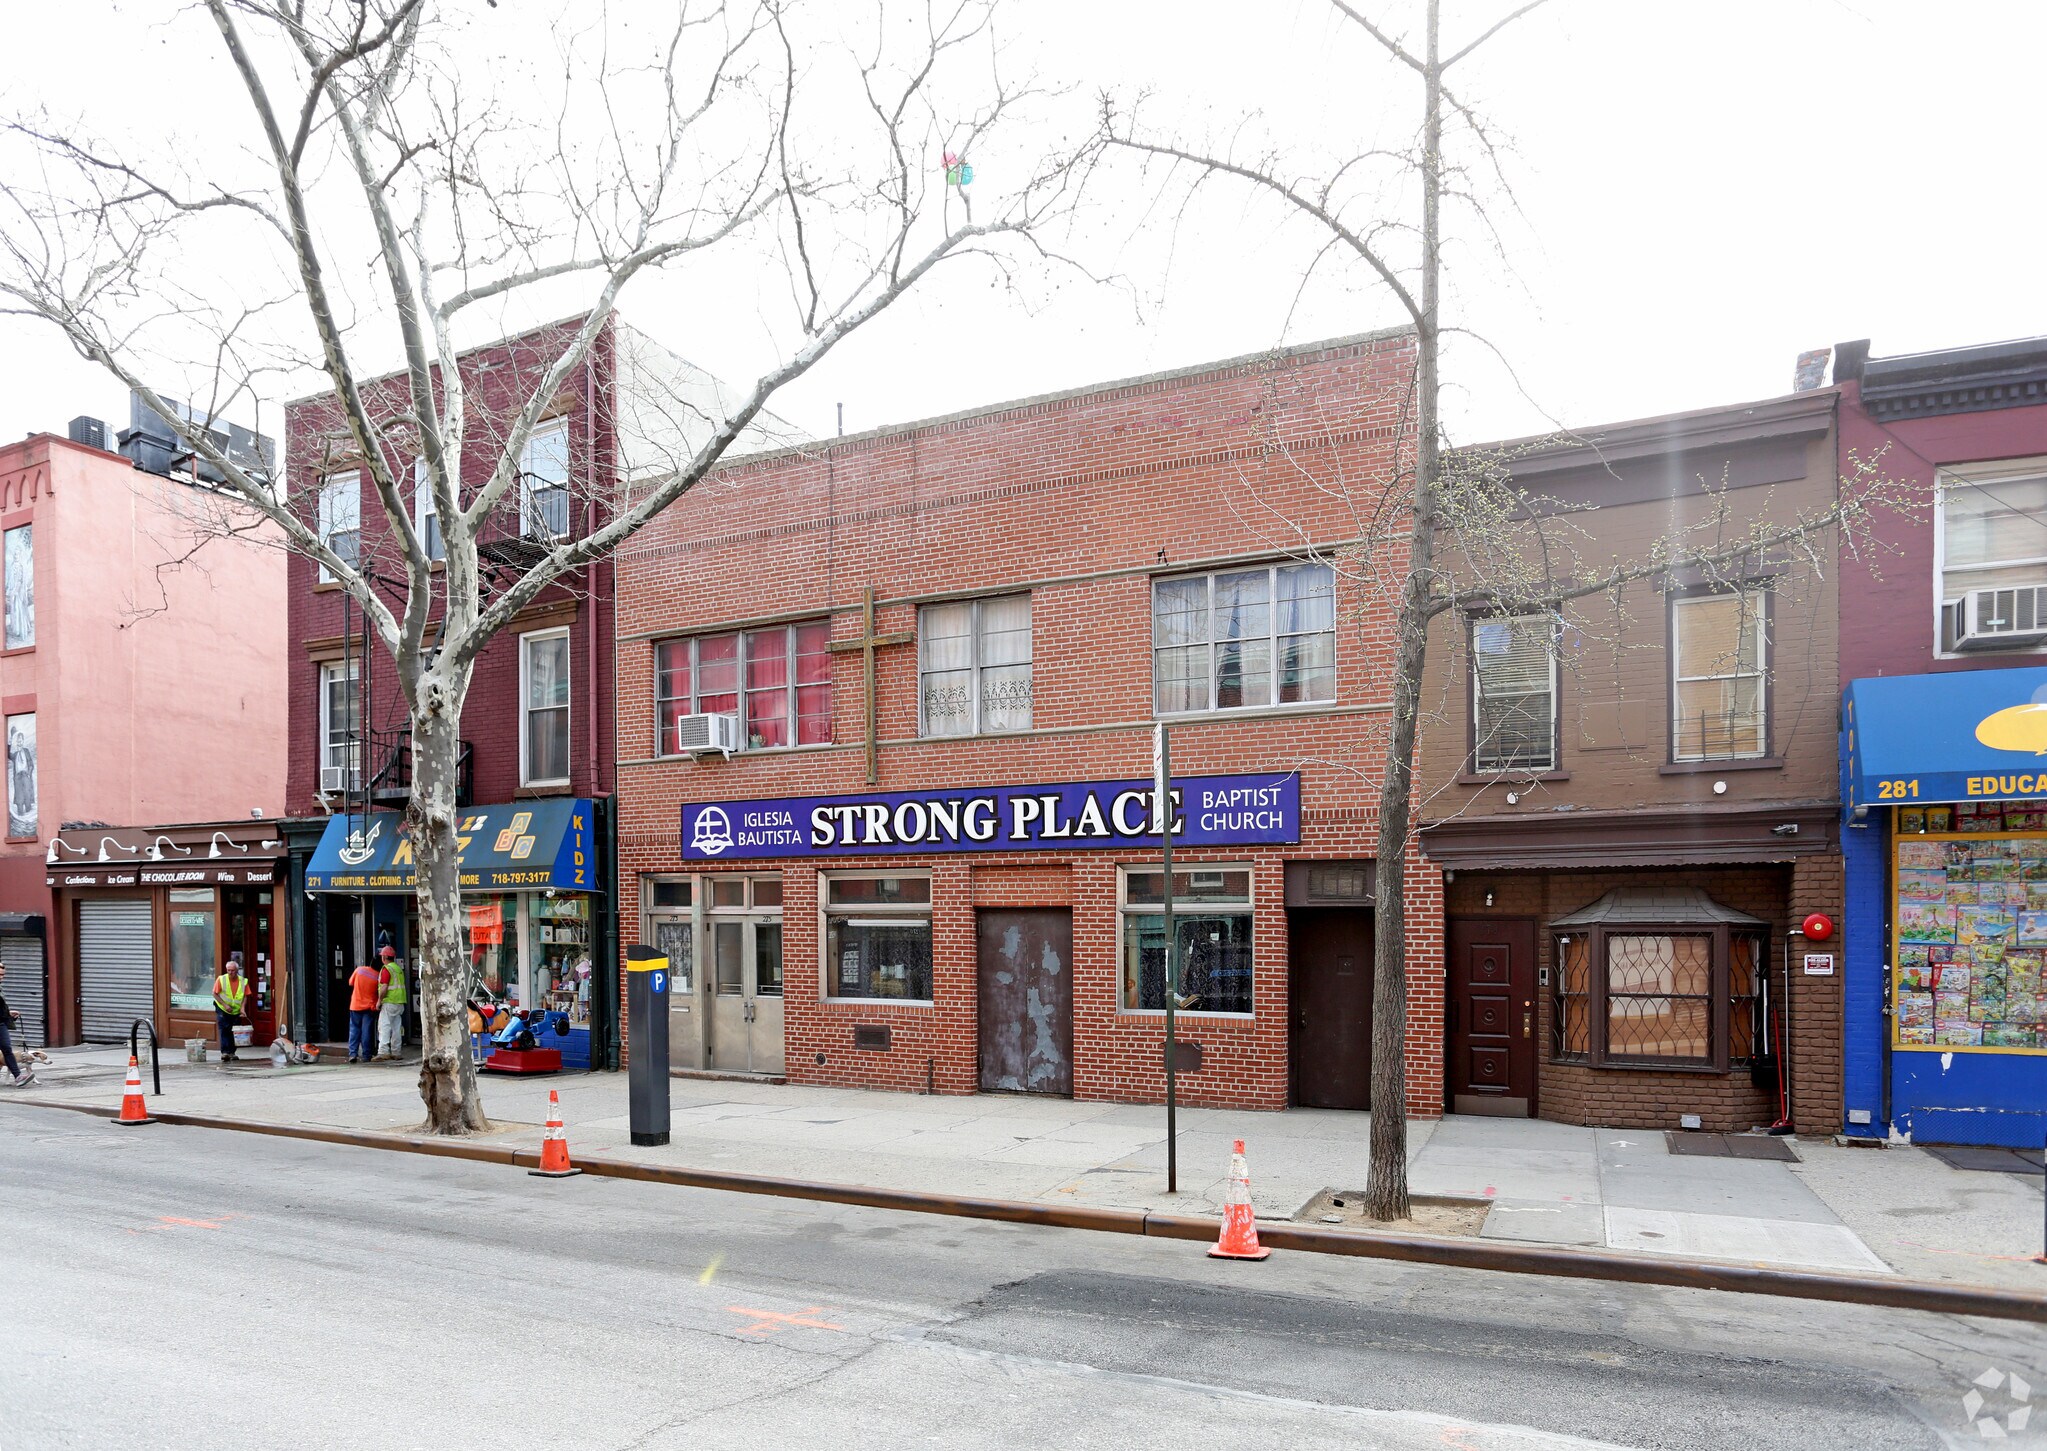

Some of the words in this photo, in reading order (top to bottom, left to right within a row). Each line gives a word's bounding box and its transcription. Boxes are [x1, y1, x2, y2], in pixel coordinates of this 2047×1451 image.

[1202, 788, 1282, 809] BAPTIST
[1878, 779, 1919, 799] 281
[744, 811, 793, 828] IGLESIA
[811, 798, 997, 846] STRONG
[1200, 811, 1284, 831] CHURCH
[738, 829, 803, 846] BAUTISTA
[573, 814, 585, 884] KIDZ
[65, 875, 96, 885] Confections
[107, 875, 116, 884] Ice
[116, 875, 135, 884] Cream
[140, 873, 151, 882] THE
[151, 872, 185, 882] CHOCOLATE
[217, 872, 235, 882] Wine
[247, 872, 272, 881] Dessert
[307, 877, 321, 887] 271
[330, 876, 365, 886] FURNITURE
[369, 876, 401, 886] CLOTHING
[492, 871, 551, 884] 718-797-3177
[654, 972, 663, 991] P
